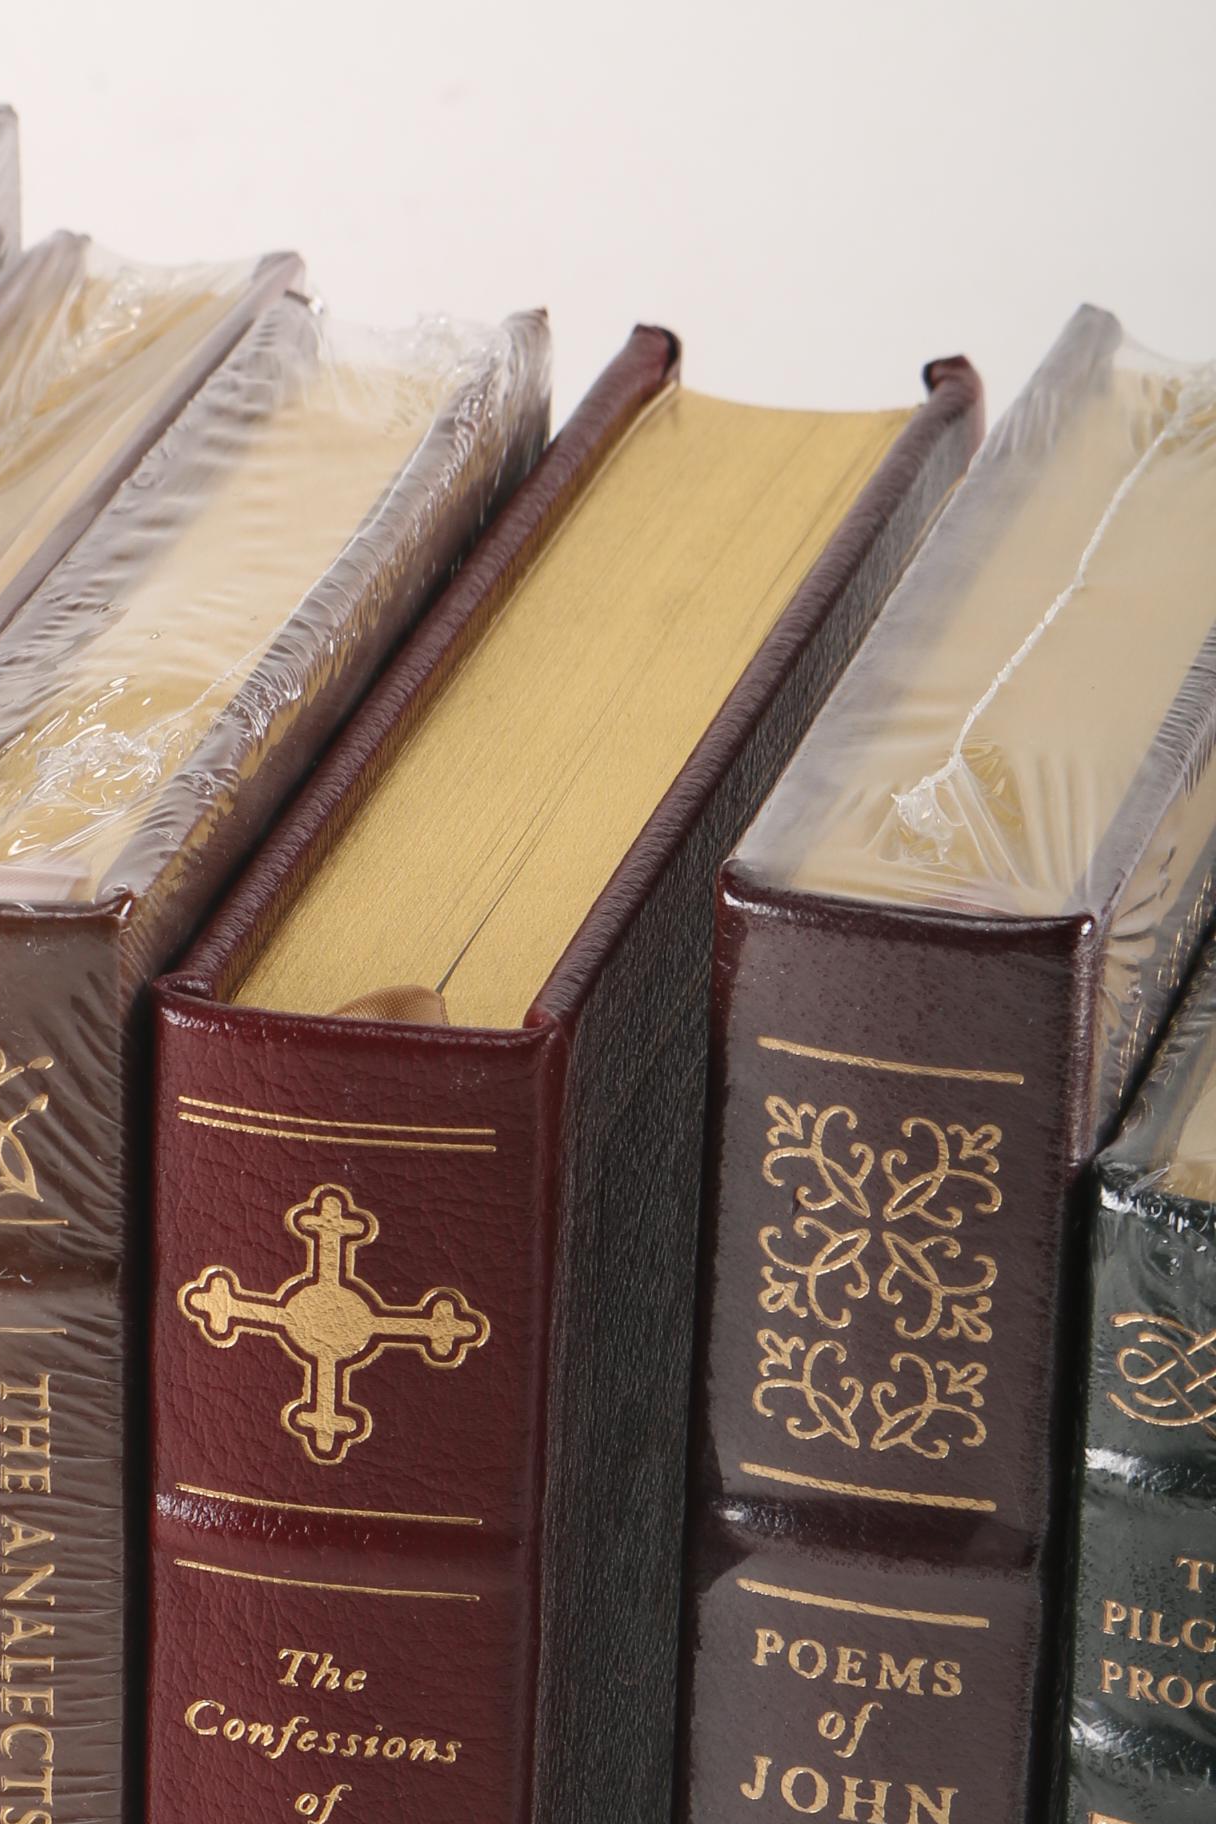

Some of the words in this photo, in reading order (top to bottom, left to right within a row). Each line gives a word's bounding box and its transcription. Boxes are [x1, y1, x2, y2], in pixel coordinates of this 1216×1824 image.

[0, 1373, 52, 1494] THE
[277, 1648, 368, 1693] The
[751, 1627, 963, 1697] POEMS
[184, 1699, 463, 1765] Confessions
[817, 1702, 884, 1759] of
